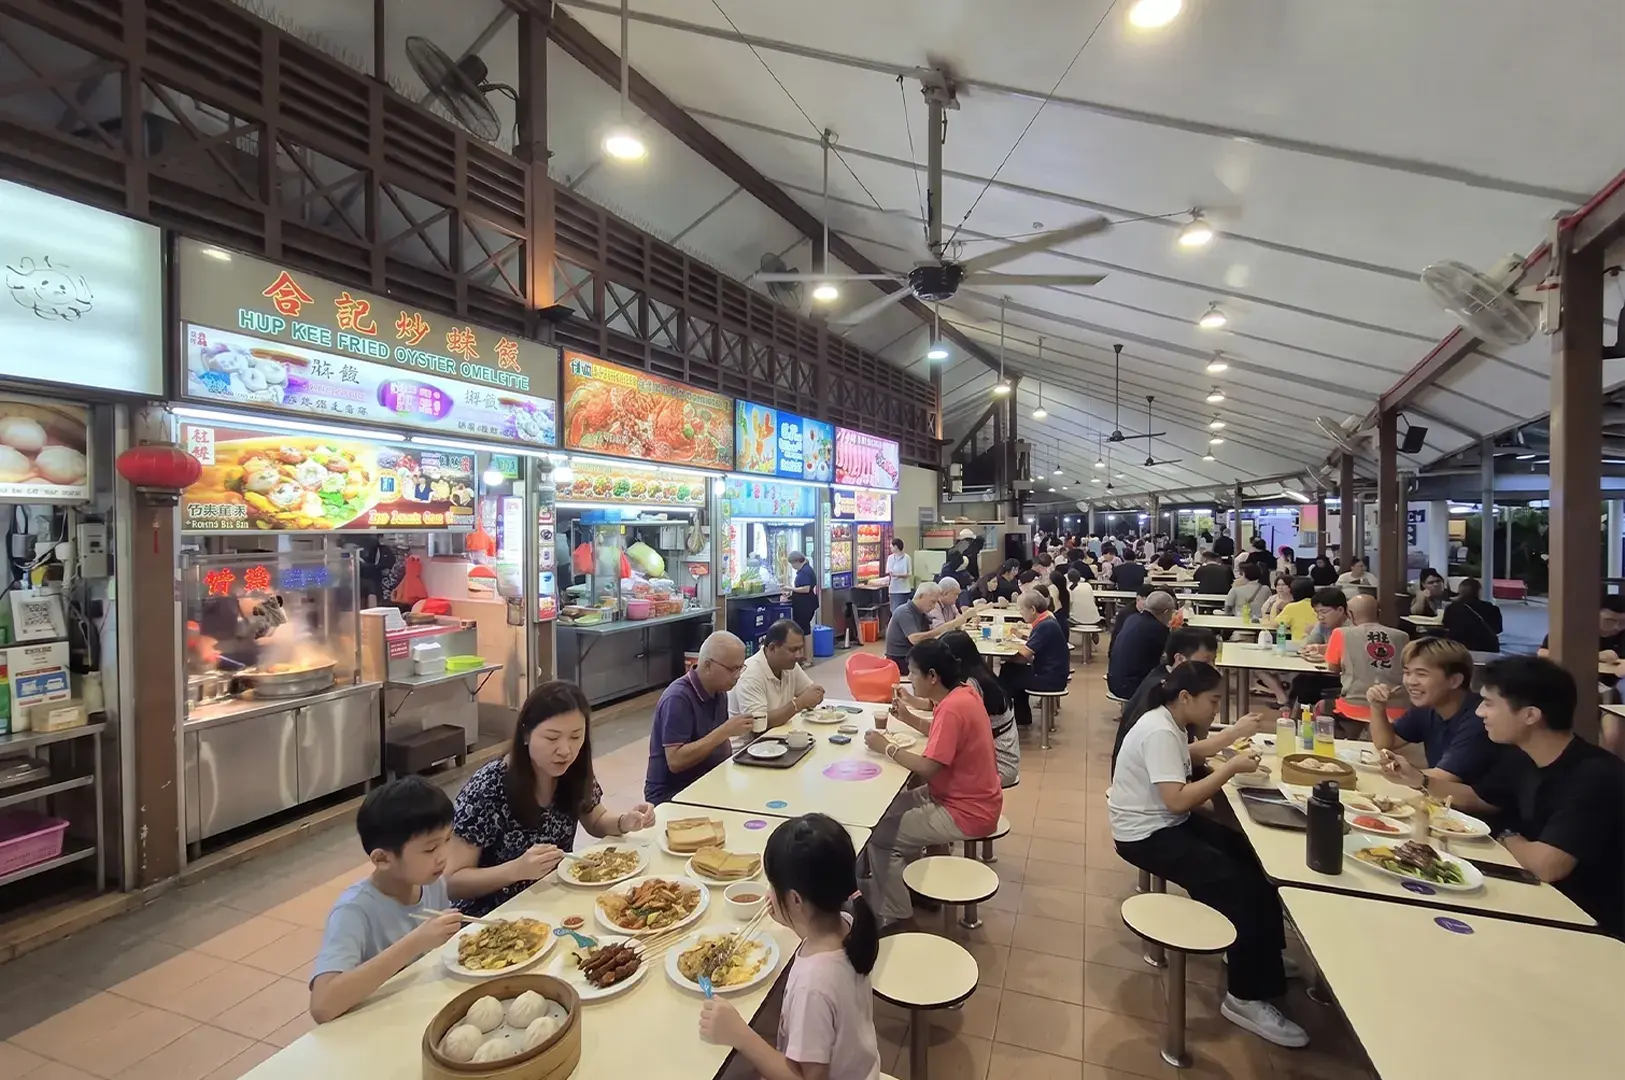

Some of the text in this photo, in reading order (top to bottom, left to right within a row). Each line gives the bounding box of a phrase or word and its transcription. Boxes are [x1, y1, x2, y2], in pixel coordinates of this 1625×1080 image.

[239, 308, 530, 391] HUP KEE FRIED OYSTER OMELETTE
